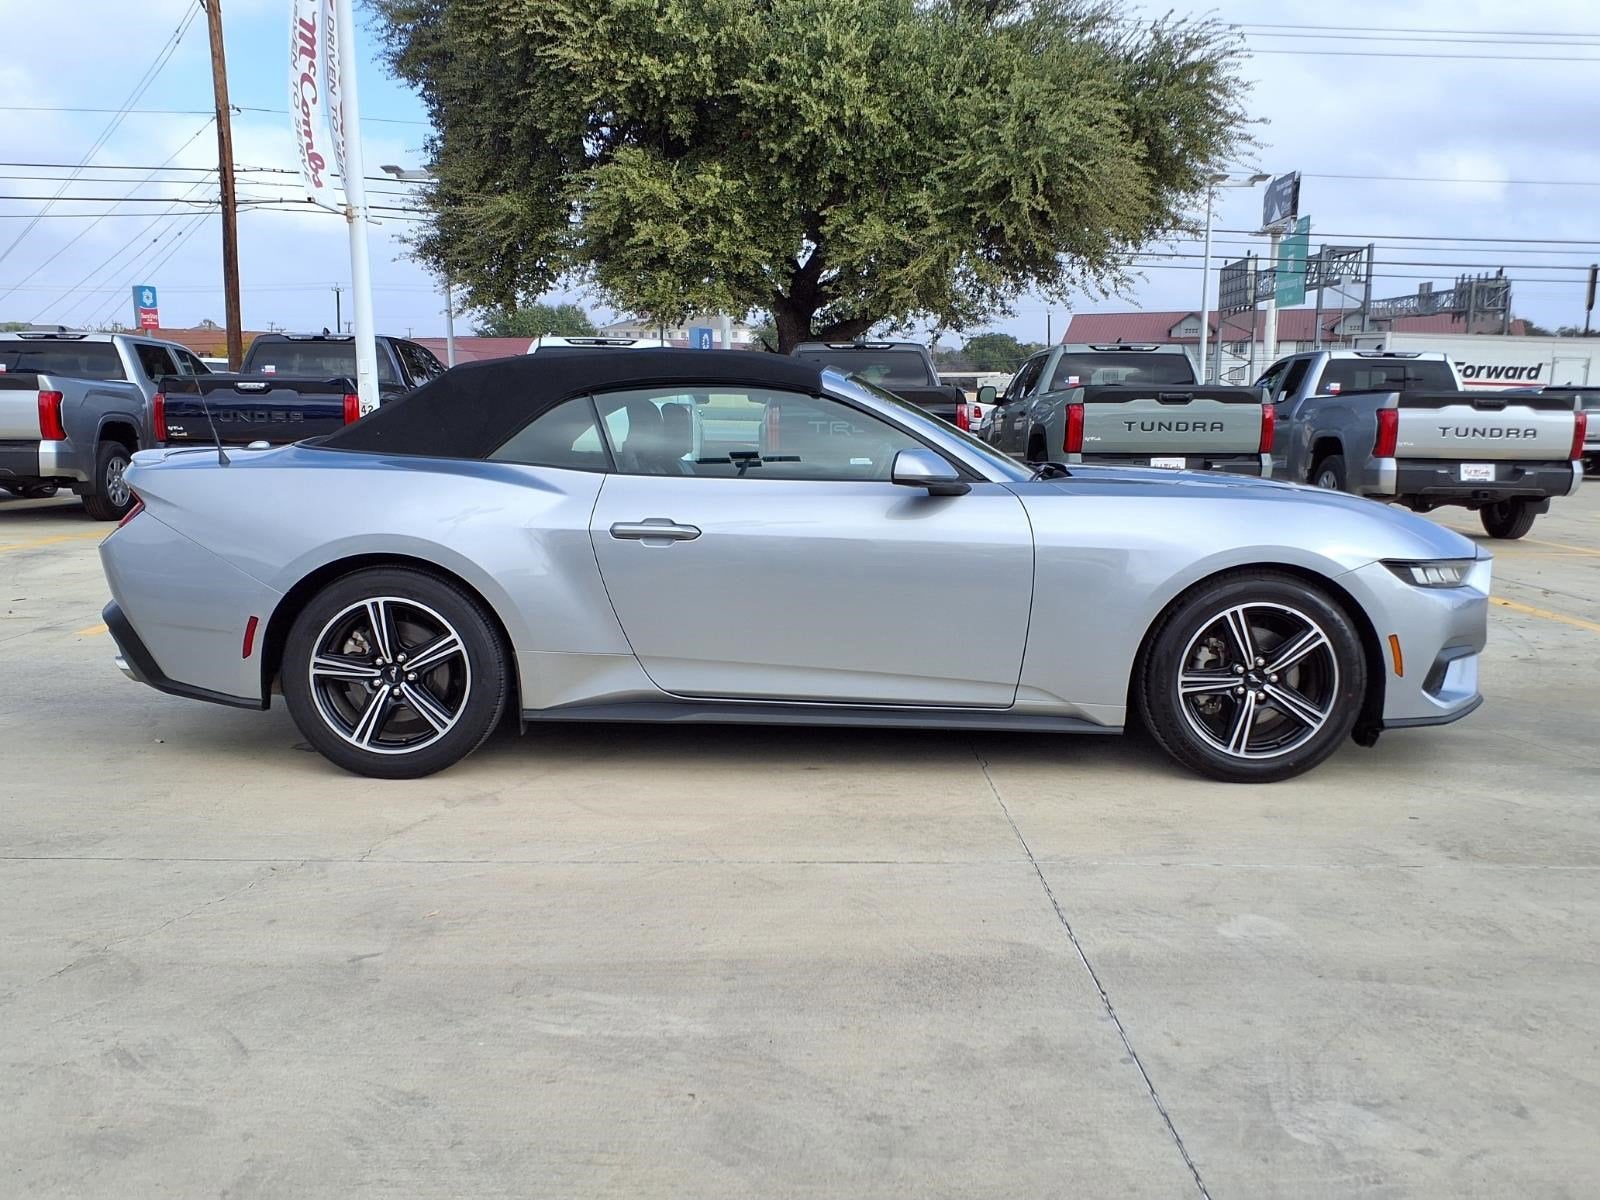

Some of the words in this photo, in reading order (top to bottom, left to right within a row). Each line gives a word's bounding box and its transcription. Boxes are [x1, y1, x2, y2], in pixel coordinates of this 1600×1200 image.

[327, 16, 337, 96] DRIVEN
[298, 11, 325, 189] McCombs
[331, 105, 338, 132] TO
[205, 411, 304, 423] UNDRA
[1124, 421, 1224, 432] TUNDRA
[1439, 427, 1537, 439] TUNDRA
